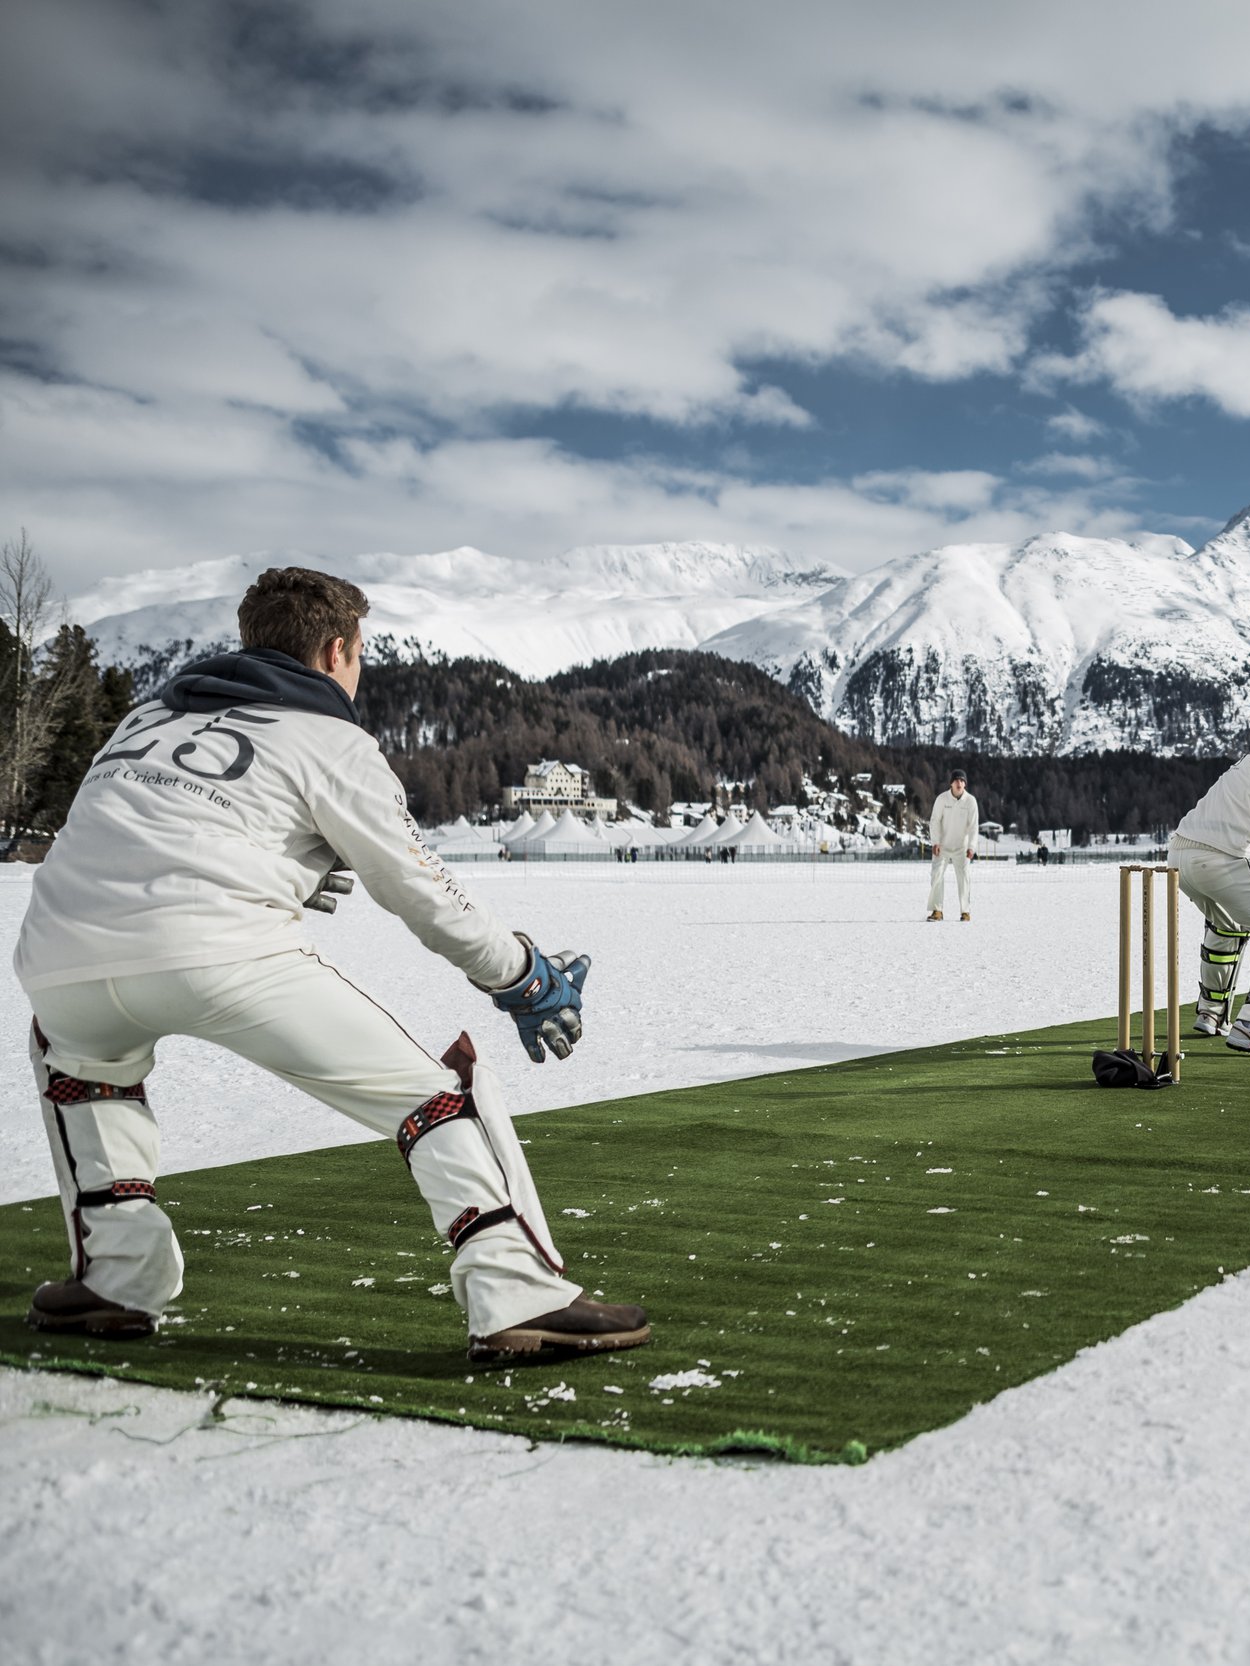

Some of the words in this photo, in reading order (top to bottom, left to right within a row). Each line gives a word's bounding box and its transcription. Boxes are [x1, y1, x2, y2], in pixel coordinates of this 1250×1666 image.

[92, 707, 280, 782] 25
[103, 767, 120, 778] of
[123, 769, 179, 787] Cricket
[184, 779, 203, 796] on
[208, 789, 231, 809] Ice
